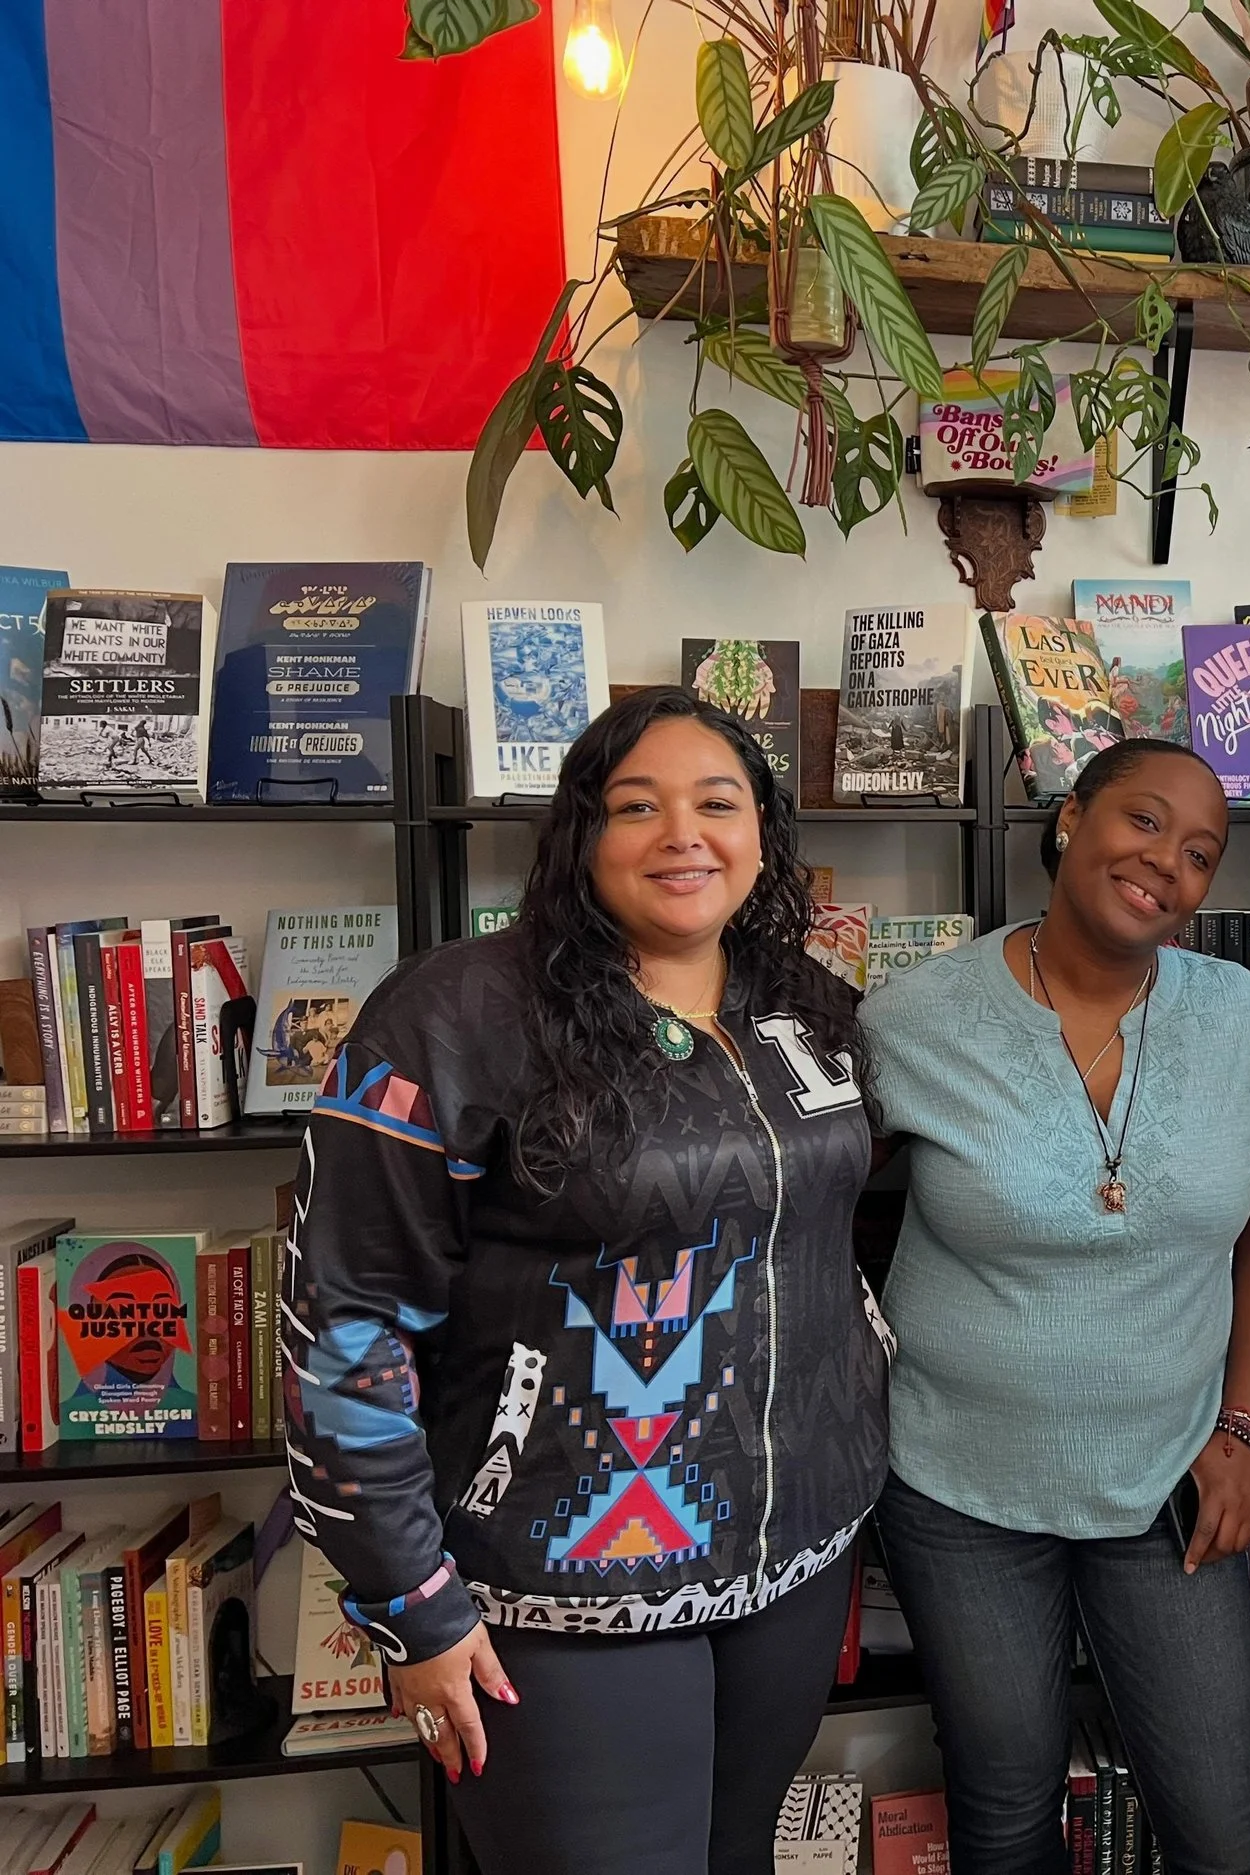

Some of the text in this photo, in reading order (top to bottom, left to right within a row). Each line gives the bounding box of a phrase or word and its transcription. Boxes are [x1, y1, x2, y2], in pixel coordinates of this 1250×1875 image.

[933, 404, 1003, 432] Bans
[937, 425, 981, 454] Off
[487, 607, 581, 620] HEAVEN LOOKS
[1096, 594, 1175, 615] NANDI
[72, 620, 162, 635] WE WANT WHITE
[852, 611, 924, 632] THE KILLING
[67, 633, 165, 648] TENANTS IN OUR
[851, 632, 900, 651] OF GAZA
[1019, 626, 1078, 654] LAST
[64, 650, 165, 663] WHITE COMMUNITY
[850, 650, 905, 670] REPORTS
[268, 667, 360, 677] SHAME
[849, 672, 875, 689] ON A
[1019, 658, 1105, 692] EVER
[70, 679, 175, 693] SETTLERS
[276, 684, 349, 692] & PREJUDICE
[847, 688, 935, 708] CATASTROPHE
[1211, 685, 1247, 714] LITTLE
[250, 735, 357, 753] HONTE ET PRÉJUGÉS
[842, 772, 924, 792] GIDEON LEVY
[278, 913, 381, 930] NOTHING MORE
[869, 920, 963, 939] LETTERS
[281, 934, 374, 950] OF THIS LAND
[194, 998, 207, 1044] SAND TALK
[88, 985, 102, 1091] INDIGENOUS INHUMANITIES
[108, 1004, 123, 1075] ALLY IS A VERB
[127, 983, 144, 1103] AFTER ONE HUNDRED WINTERS
[751, 1012, 863, 1119] L
[68, 1303, 187, 1320] QUANTUM
[80, 1321, 177, 1338] JUSTICE
[69, 1409, 192, 1422] CRYSTAL LEIGH
[94, 1422, 166, 1435] ENDSLEY
[111, 1576, 130, 1719] PAGEBOY ELLIOT PAGE
[301, 1677, 383, 1700] SEASON
[296, 1715, 389, 1734] SEASON
[878, 1809, 908, 1824] Moral
[879, 1822, 933, 1838] Abdication
[927, 1843, 943, 1852] How
[912, 1854, 936, 1864] World
[918, 1865, 945, 1874] to Stop
